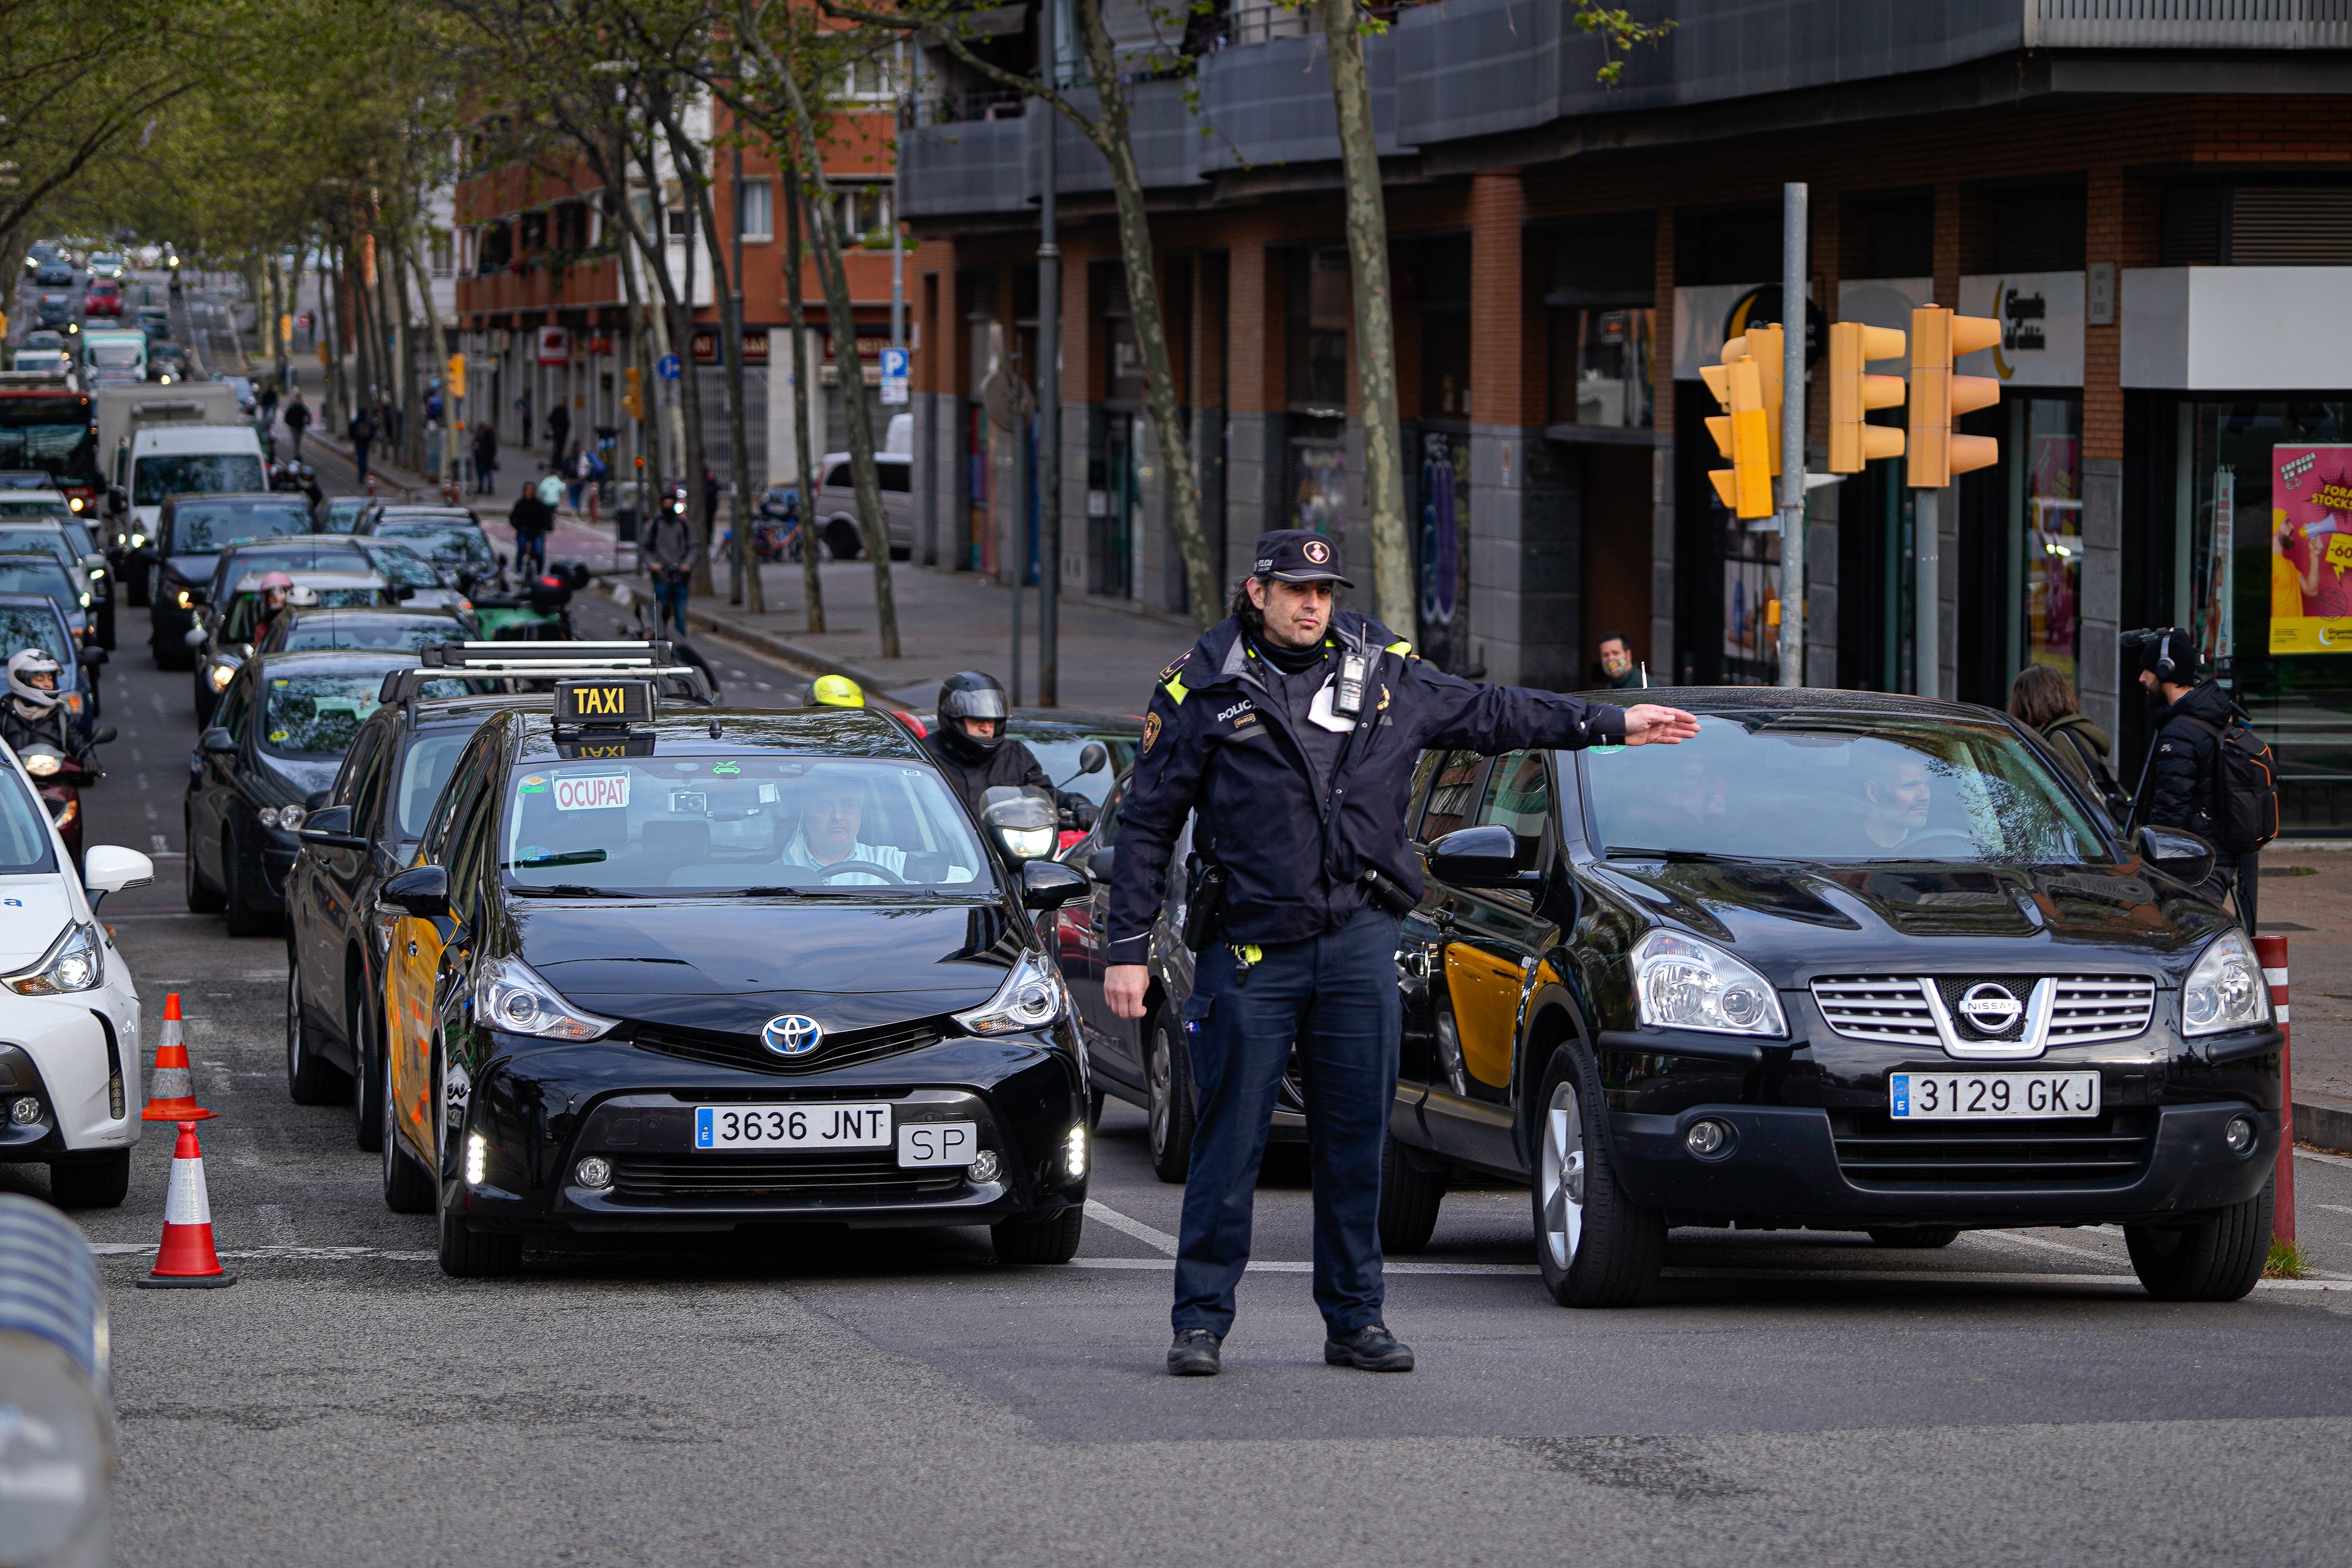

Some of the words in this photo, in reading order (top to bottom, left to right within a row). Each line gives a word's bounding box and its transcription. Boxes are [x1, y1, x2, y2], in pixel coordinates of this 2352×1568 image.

[886, 352, 903, 377] P
[573, 688, 624, 714] TAXI
[559, 779, 624, 807] OCUPAT
[1897, 1101, 1906, 1110] E
[1920, 1079, 2010, 1111] 3129
[2029, 1079, 2093, 1111] GKJ
[721, 1112, 807, 1140] 3636
[821, 1110, 883, 1139] JNT
[912, 1129, 965, 1159] SP
